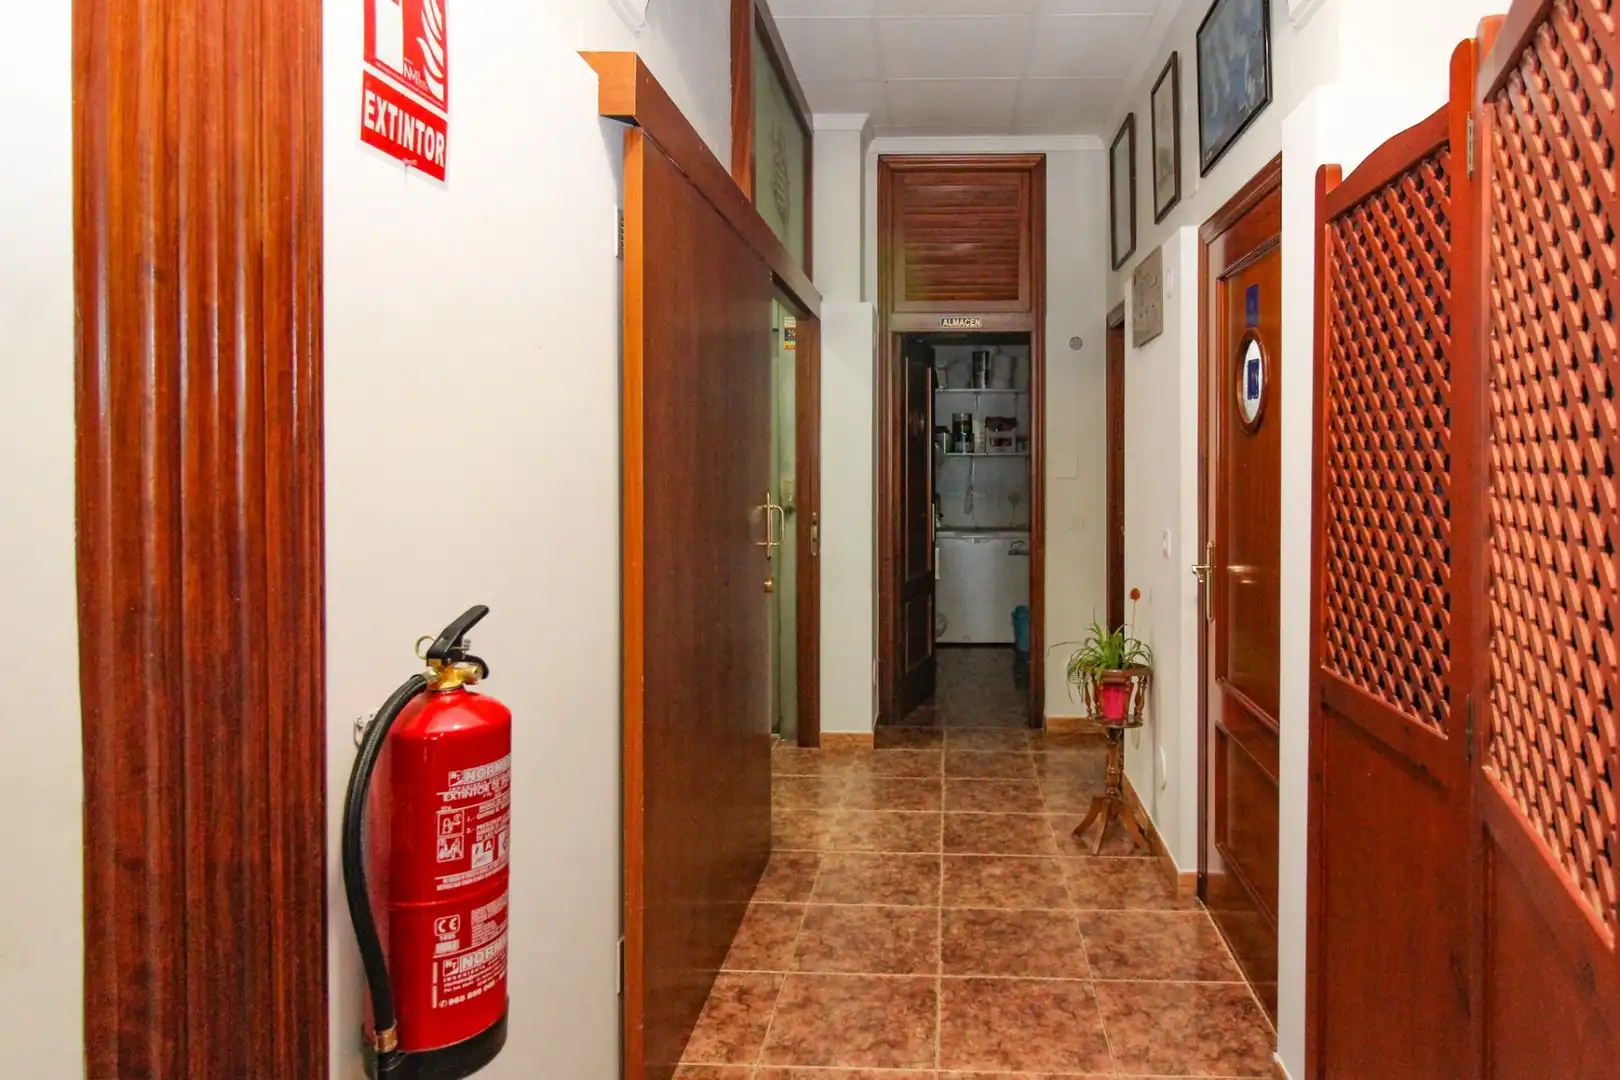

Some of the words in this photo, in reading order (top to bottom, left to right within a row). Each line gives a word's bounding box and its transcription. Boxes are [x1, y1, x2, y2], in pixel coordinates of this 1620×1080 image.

[364, 88, 445, 168] EXTINTOR
[942, 318, 981, 327] ALMACEN
[443, 784, 491, 802] EXTINTOR
